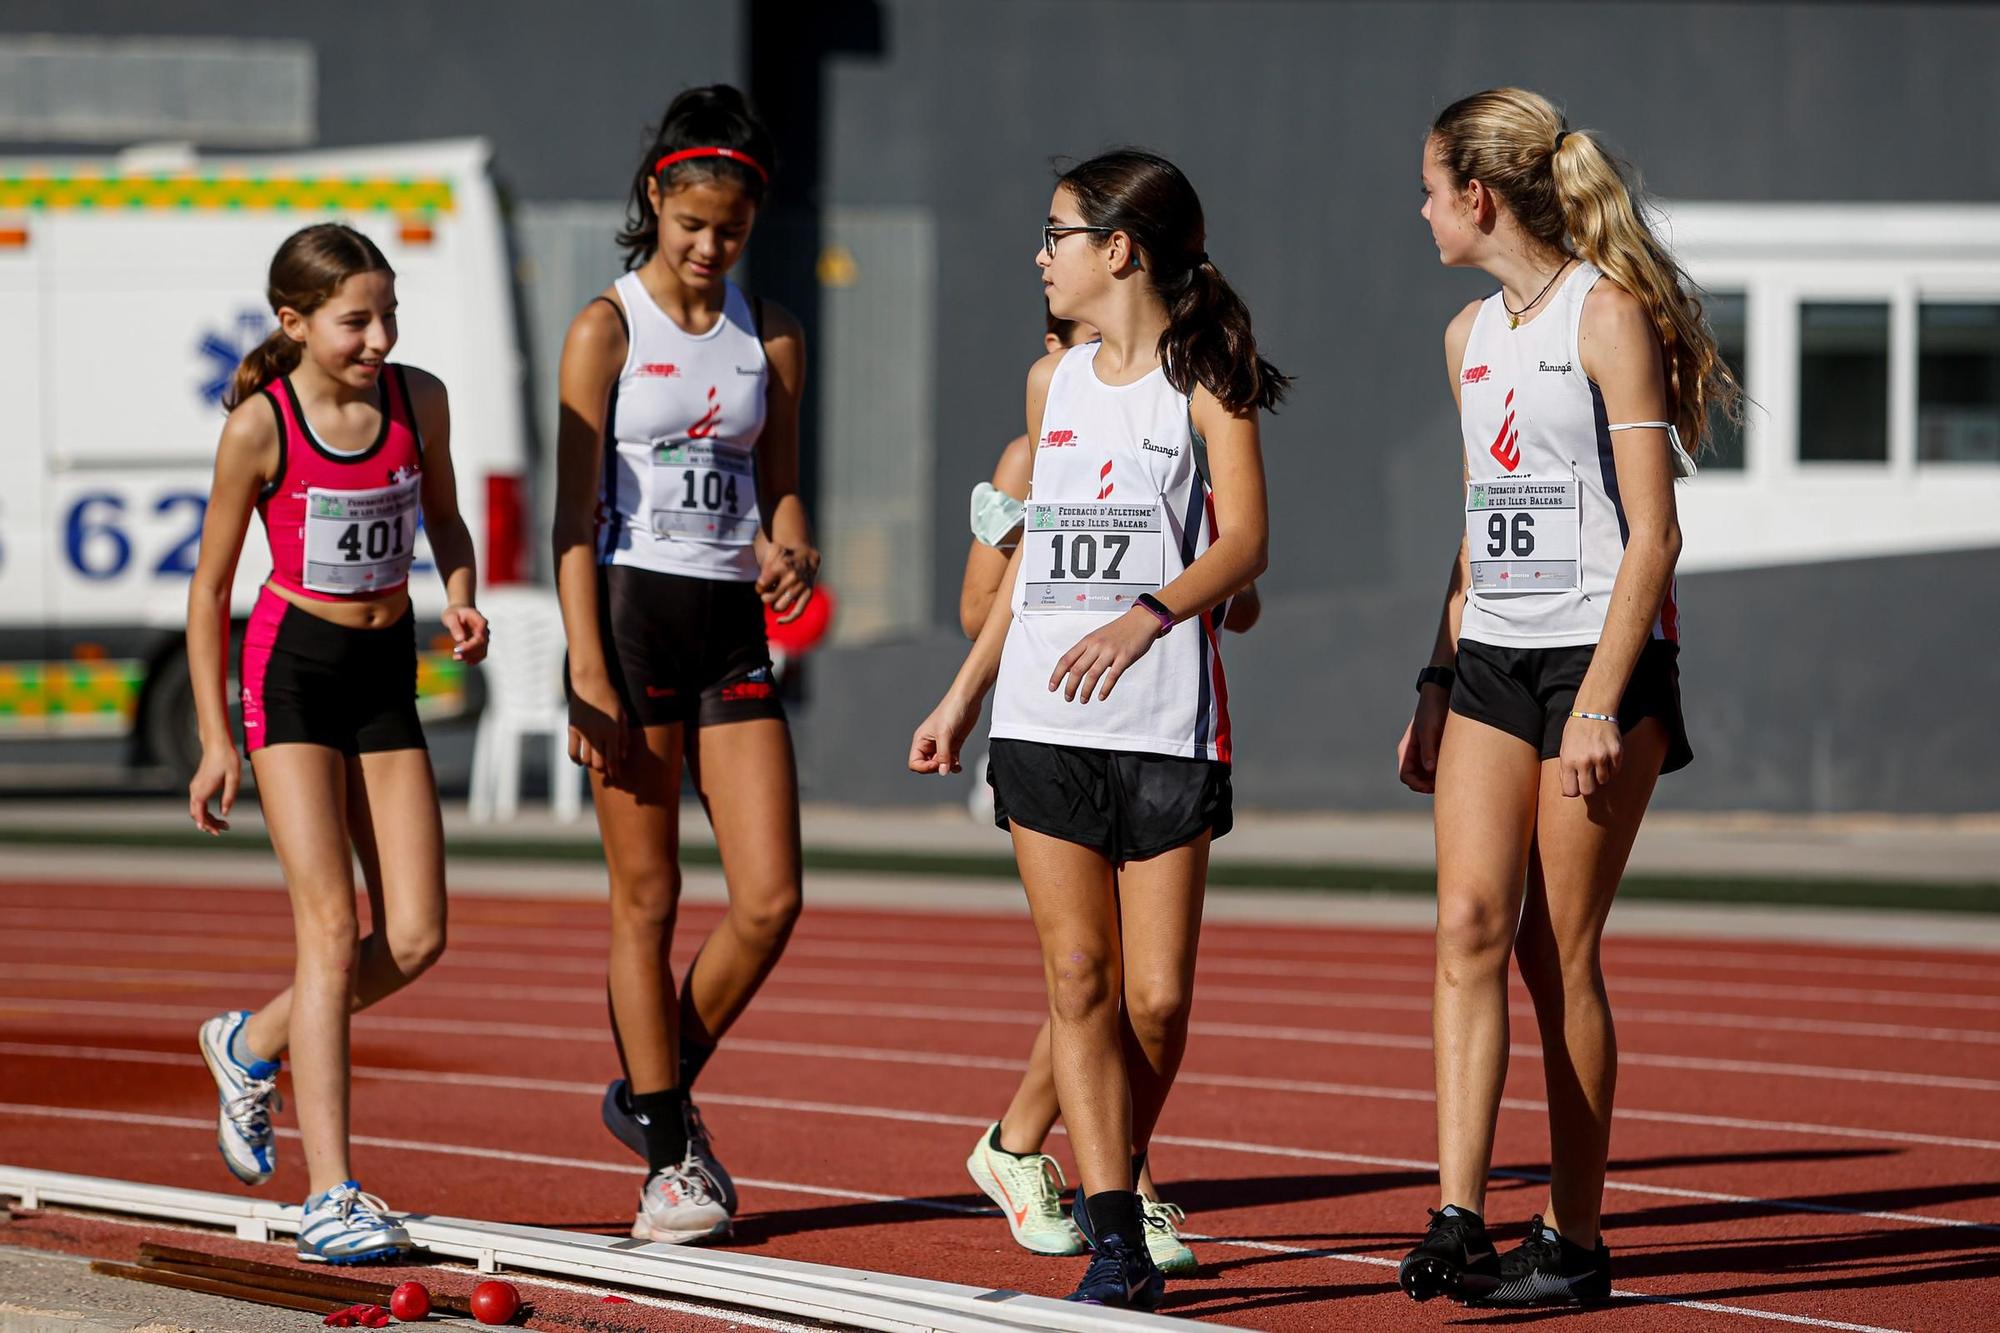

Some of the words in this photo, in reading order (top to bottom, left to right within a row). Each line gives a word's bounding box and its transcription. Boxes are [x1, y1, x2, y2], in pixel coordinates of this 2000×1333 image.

[1539, 361, 1572, 374] Runing's
[1142, 438, 1180, 458] Runing's
[682, 470, 738, 514] 104
[337, 516, 403, 561] 401
[1050, 534, 1130, 580] 107
[1487, 513, 1534, 557] 96
